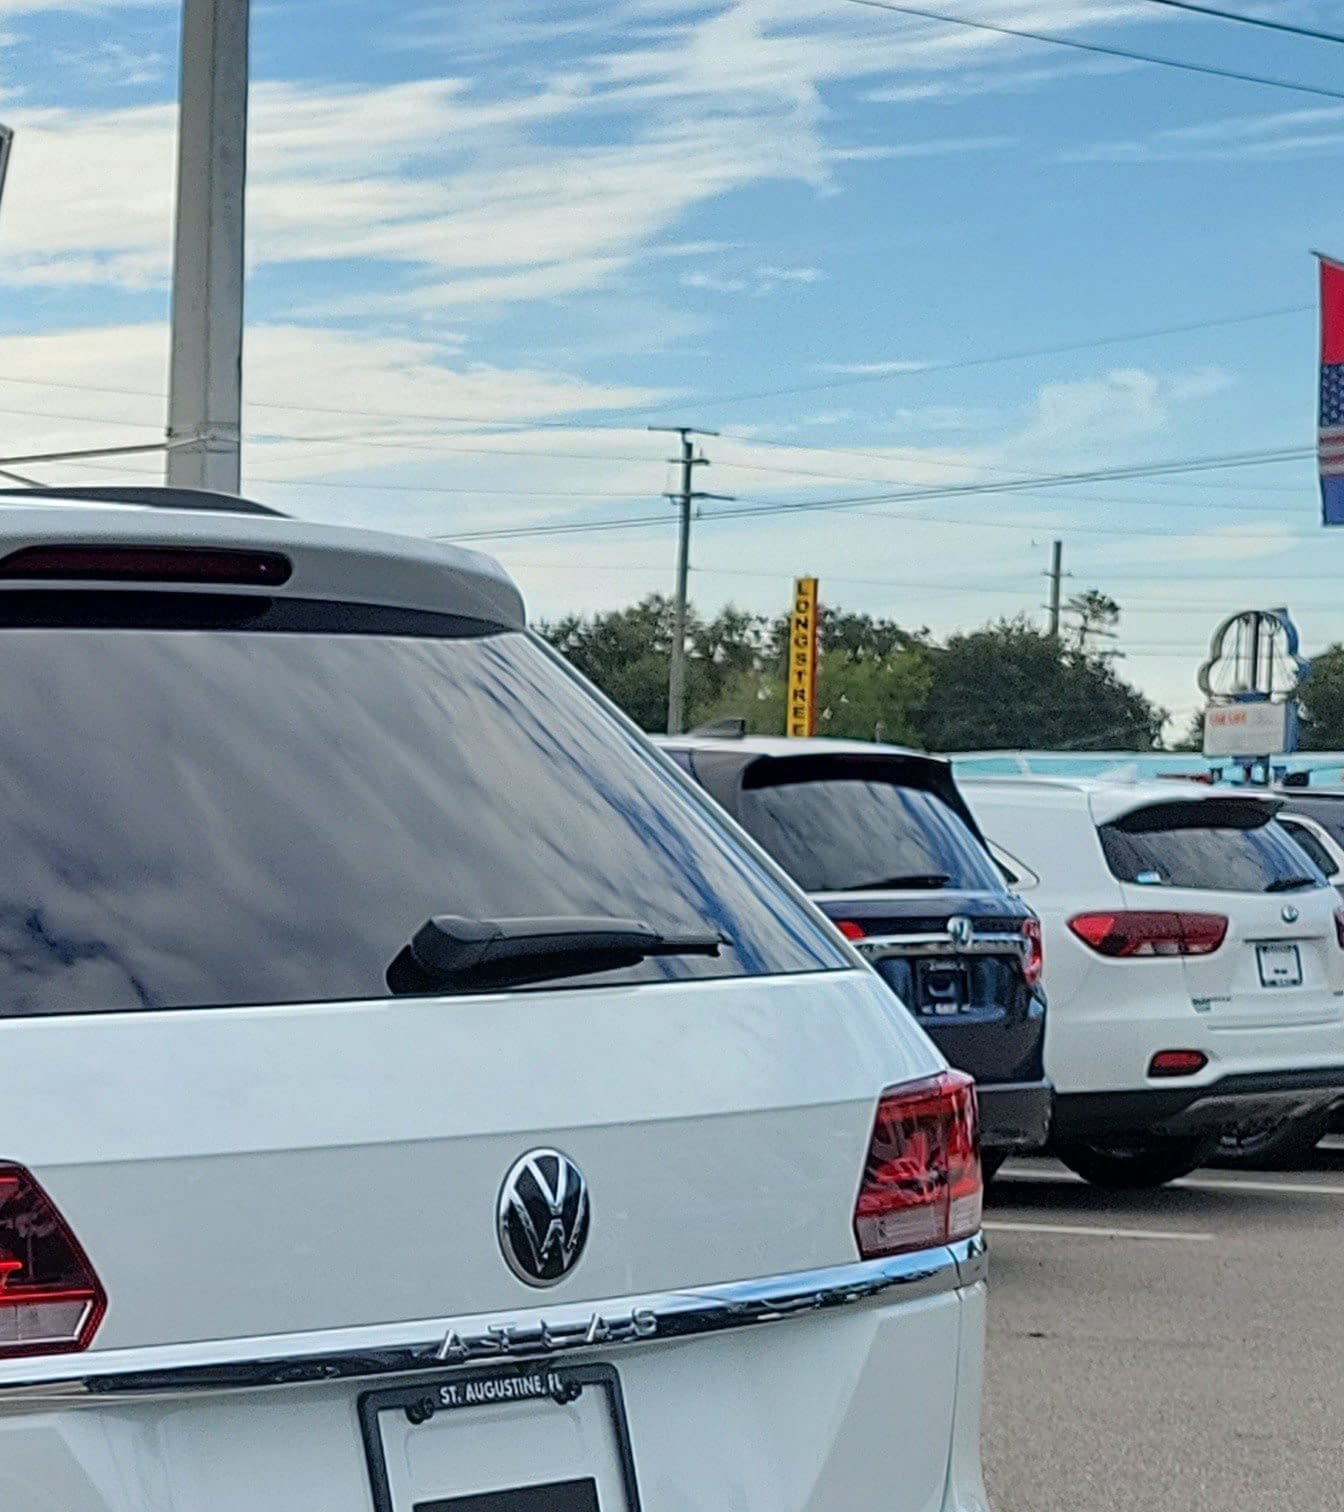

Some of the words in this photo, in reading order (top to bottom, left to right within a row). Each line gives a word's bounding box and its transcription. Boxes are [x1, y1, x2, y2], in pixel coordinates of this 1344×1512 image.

[436, 1307, 658, 1360] ATLAS
[440, 1386, 462, 1405] ST.
[466, 1375, 546, 1402] AUGUSTINE,
[547, 1373, 564, 1392] FL
